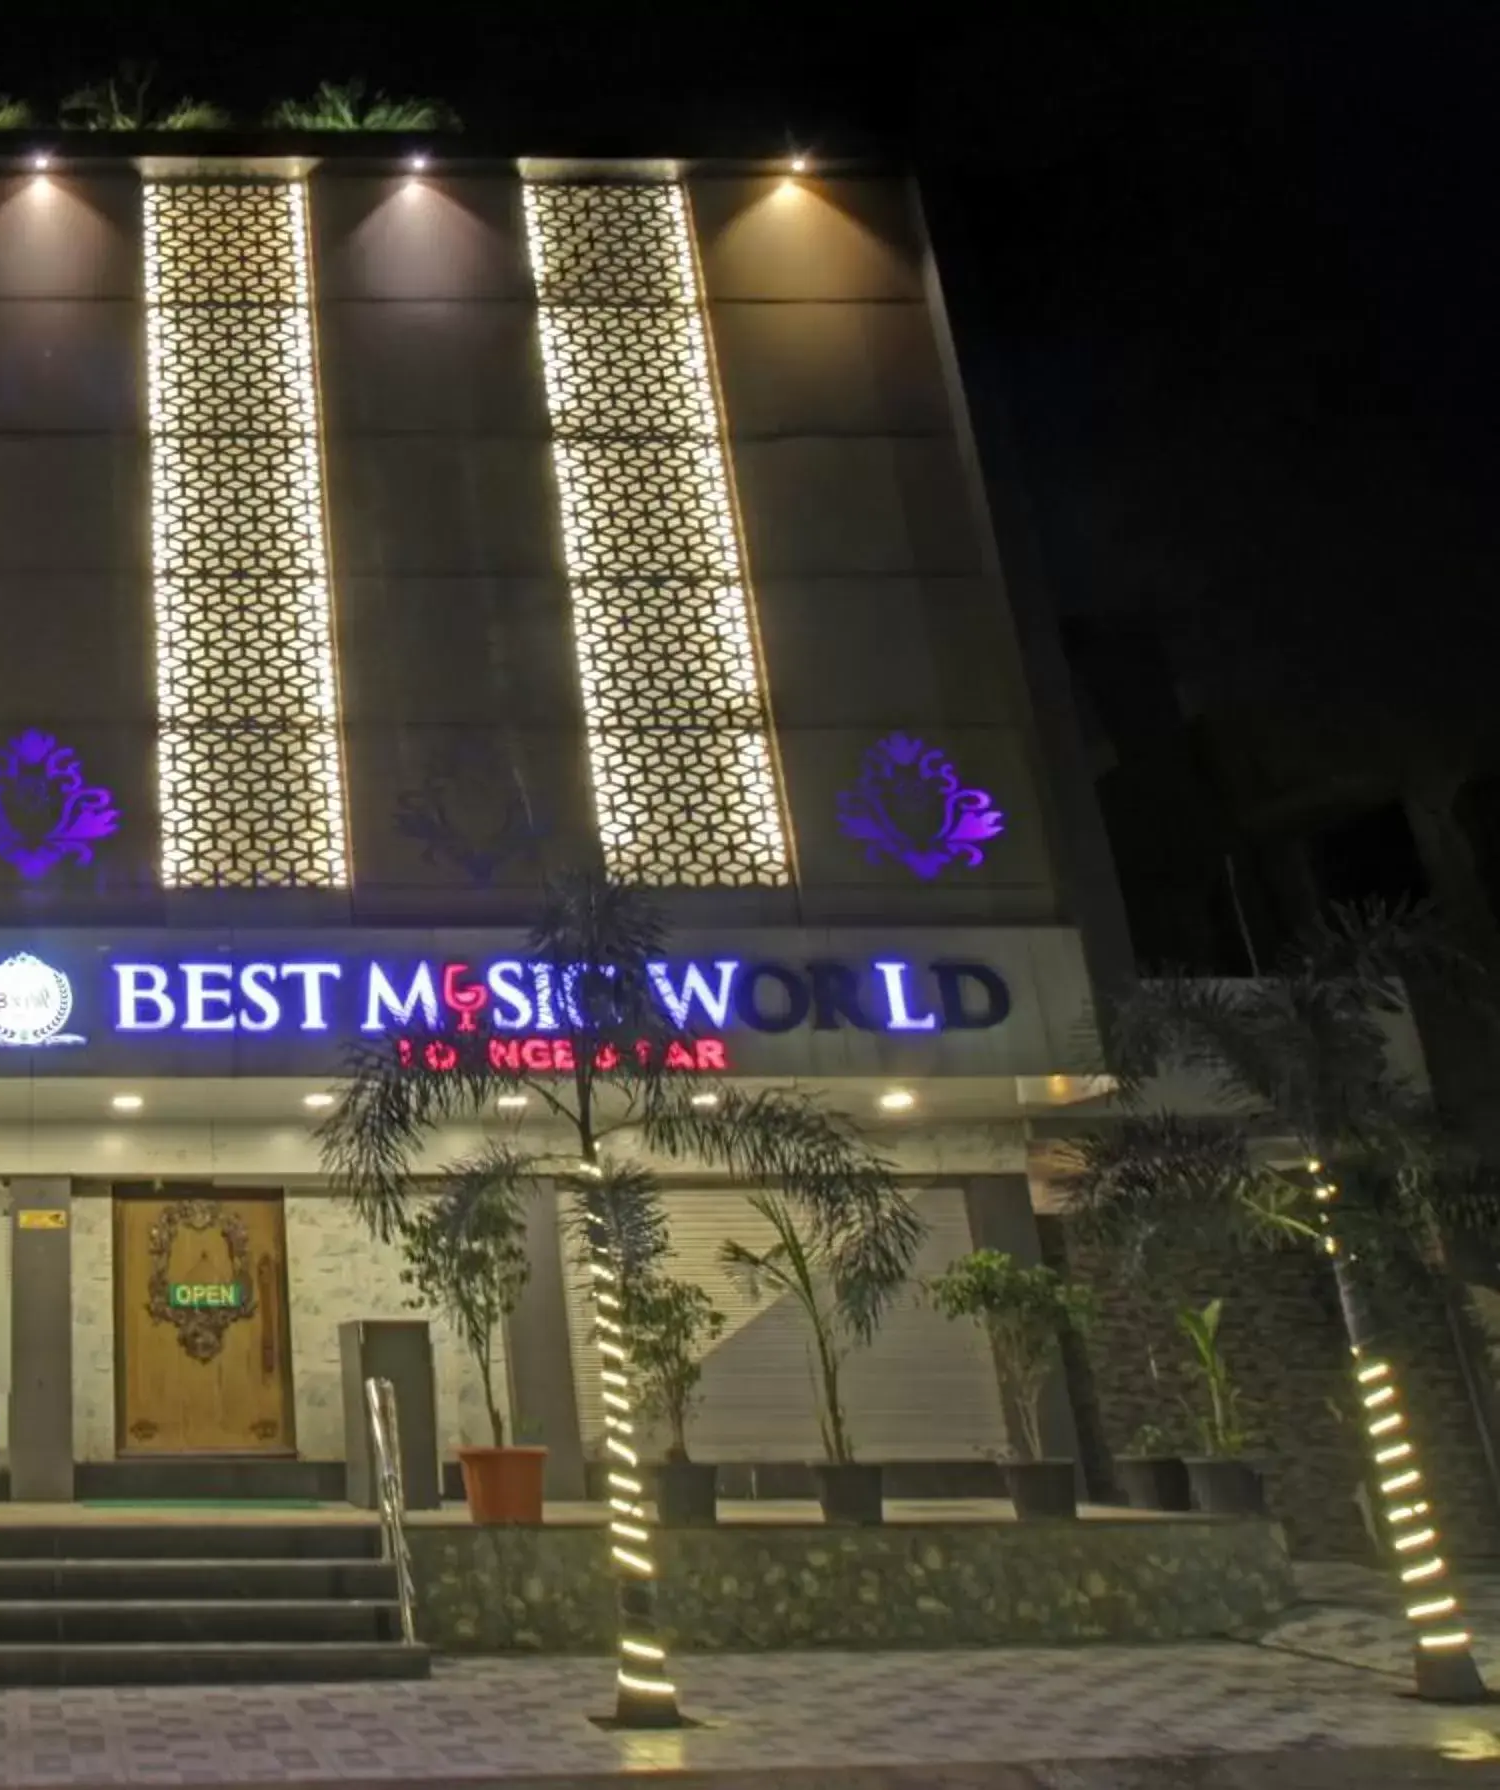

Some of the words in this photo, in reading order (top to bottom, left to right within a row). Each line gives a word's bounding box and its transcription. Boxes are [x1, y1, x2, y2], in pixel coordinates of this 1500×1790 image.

[111, 962, 342, 1032] BEST
[646, 960, 1011, 1034] WORLD
[175, 1284, 236, 1305] OPEN
